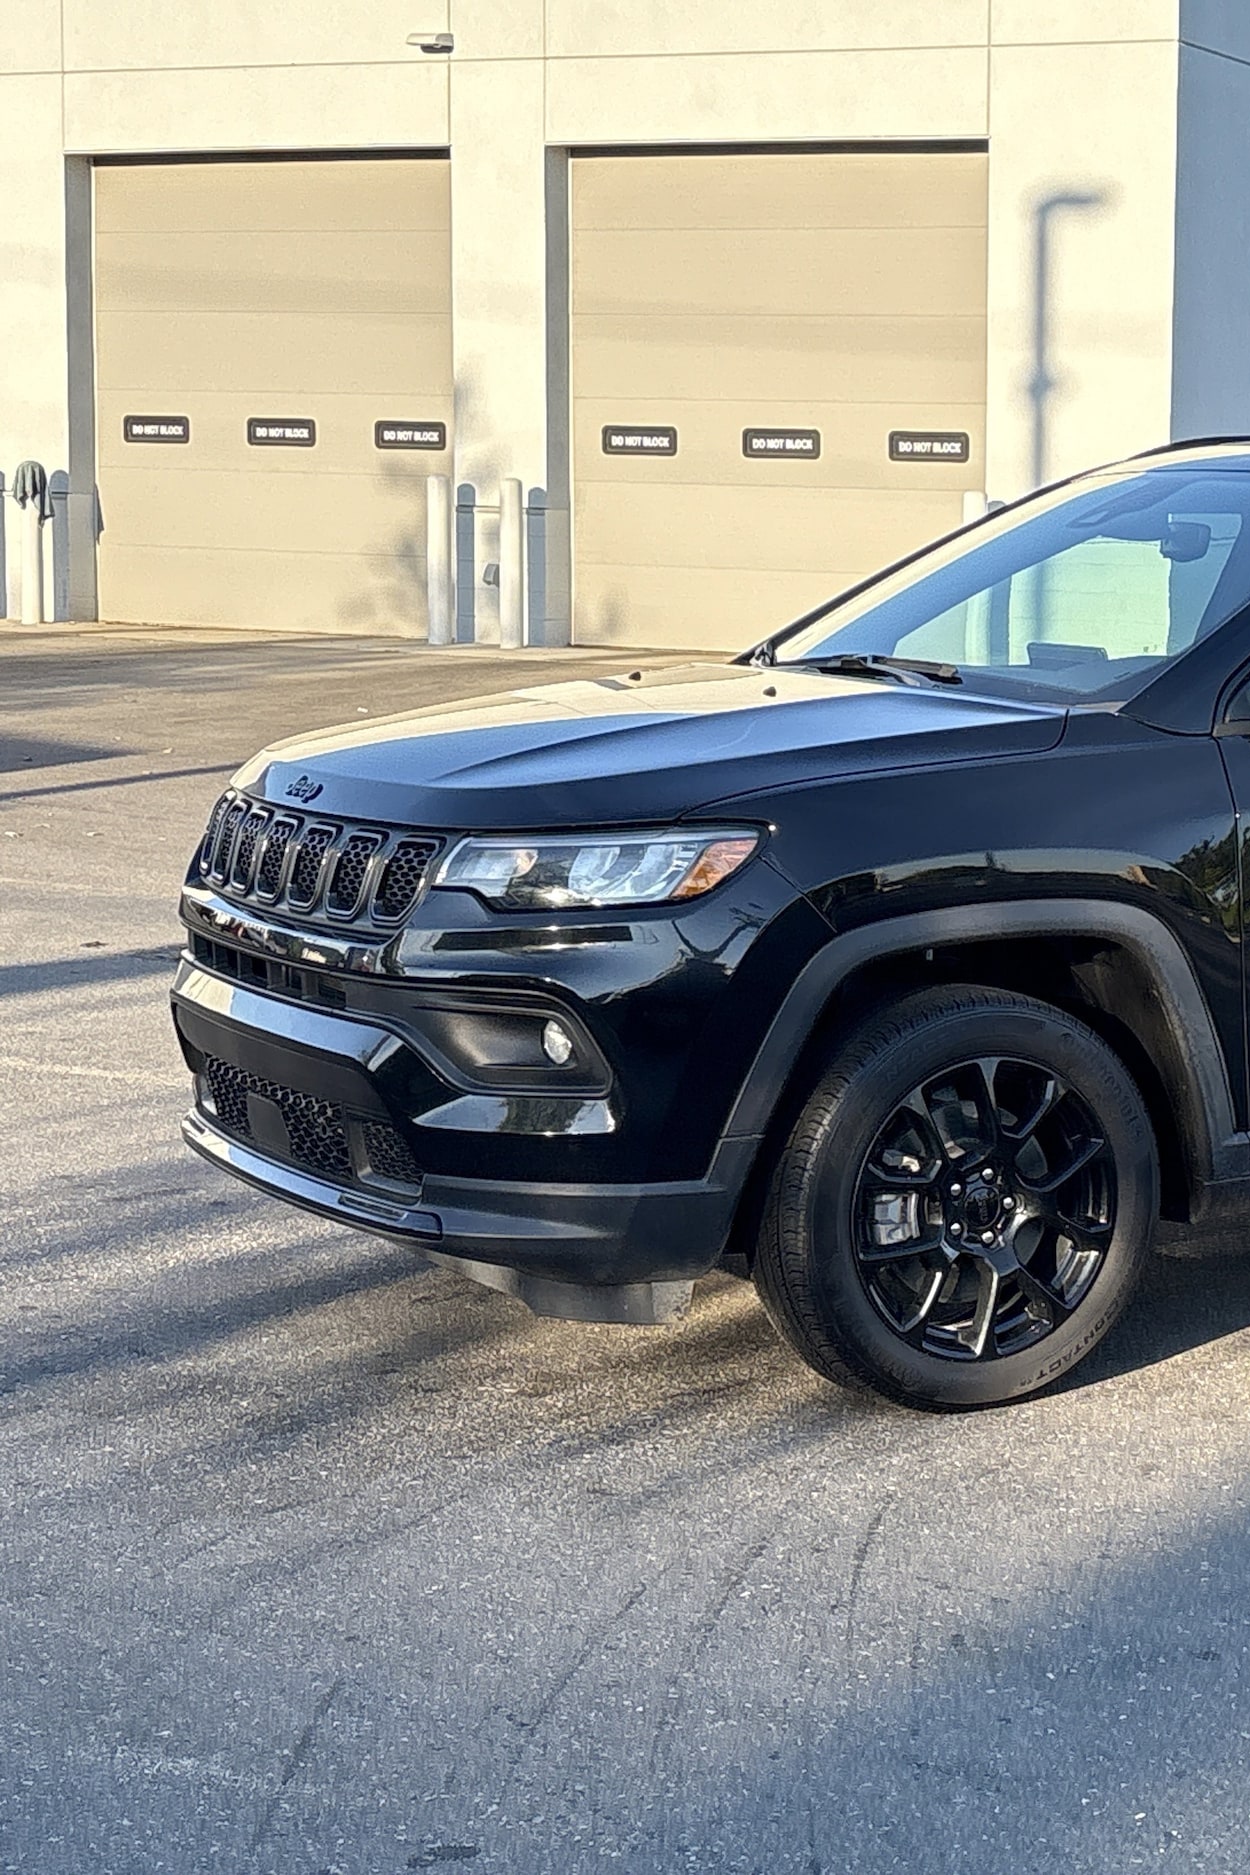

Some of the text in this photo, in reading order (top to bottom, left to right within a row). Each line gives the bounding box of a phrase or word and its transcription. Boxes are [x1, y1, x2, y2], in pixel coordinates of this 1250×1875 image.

[132, 424, 184, 435] DO NOT BLOCK
[256, 427, 309, 438] DO NOT BLOCK
[383, 430, 440, 442] DO NOT BLOCK
[611, 435, 670, 447] DO NOT BLOCK
[752, 438, 814, 450] DO NOT BLOCK
[898, 441, 962, 453] DO NOT BLOCK
[285, 774, 324, 804] Jeep
